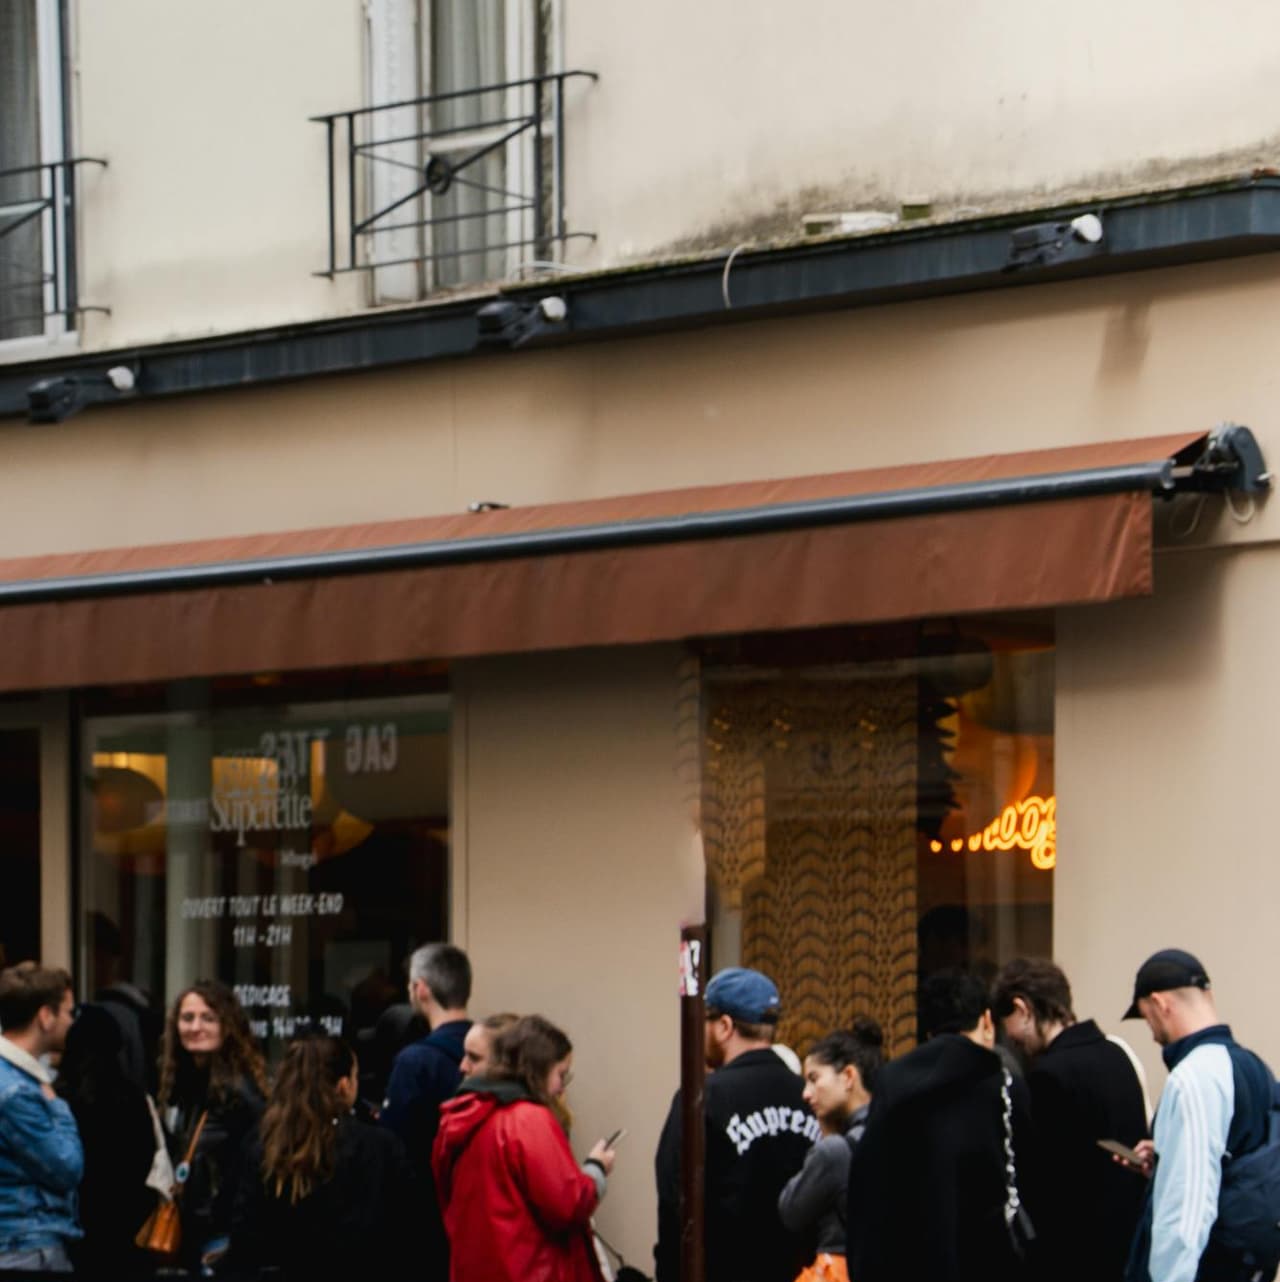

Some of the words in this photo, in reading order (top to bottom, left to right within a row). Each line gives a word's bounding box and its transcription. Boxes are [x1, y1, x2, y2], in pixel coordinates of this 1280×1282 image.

[181, 897, 225, 919] OUVERT
[229, 896, 260, 917] TOUT
[262, 895, 278, 916] LE
[279, 892, 344, 916] WEEK-END
[233, 925, 256, 947] 11H
[265, 924, 293, 947] 21H
